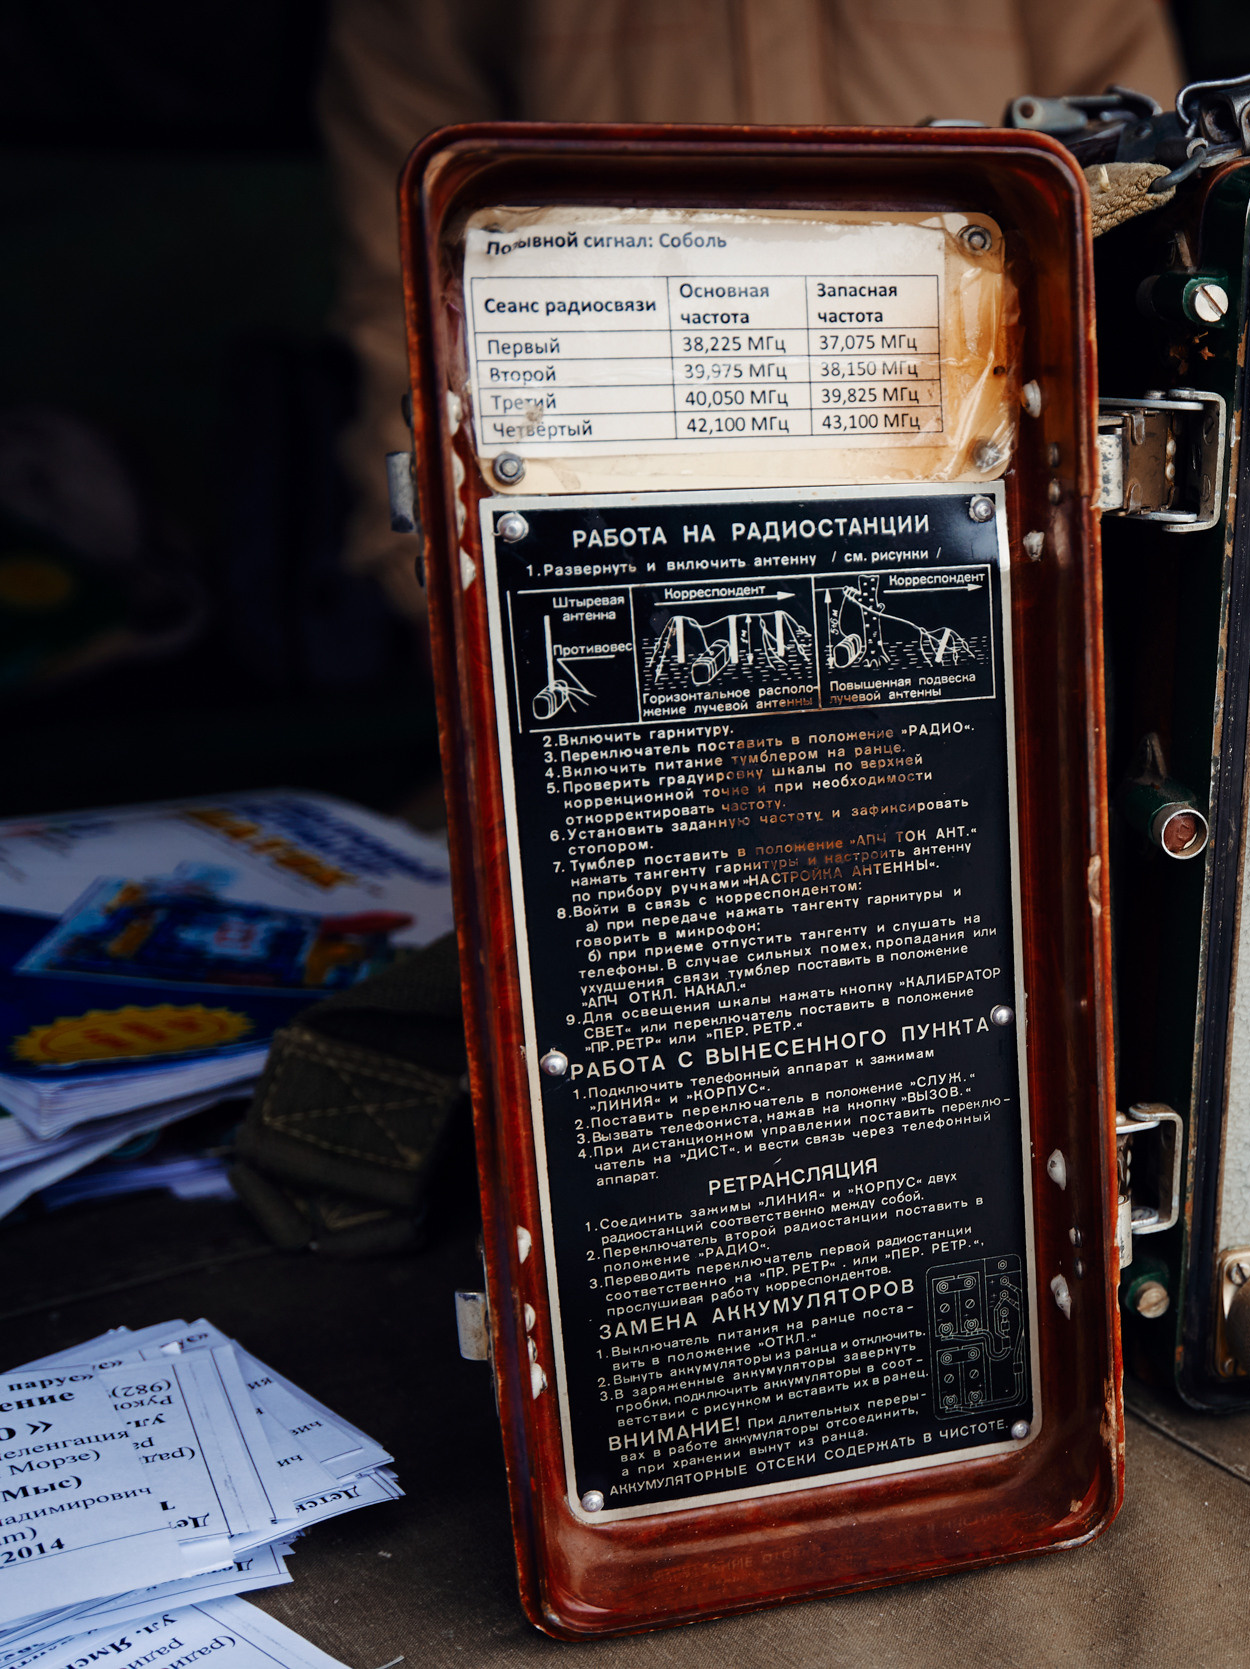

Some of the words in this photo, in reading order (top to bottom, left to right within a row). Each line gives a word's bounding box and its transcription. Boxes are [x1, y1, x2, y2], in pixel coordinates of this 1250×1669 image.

[583, 235, 653, 249] сигнал:
[658, 232, 728, 249] Соболь
[679, 282, 770, 299] Основная
[816, 282, 898, 298] Запасная
[484, 297, 540, 314] Сеанс
[545, 298, 657, 316] радиосвязи
[680, 311, 750, 325] частота
[817, 310, 884, 323] частота
[487, 337, 561, 358] Первый
[682, 335, 742, 354] 38,225
[748, 334, 787, 353] МГц
[819, 334, 875, 353] 37,075
[880, 333, 918, 351] МГц
[489, 365, 557, 386] Второй
[684, 362, 743, 382] 39,975
[749, 361, 788, 380] МГц
[820, 361, 877, 380] 38,150
[882, 360, 919, 378] МГц
[490, 392, 557, 413] Третий
[685, 389, 745, 409] 40,050
[750, 388, 789, 407] МГц
[821, 387, 878, 407] 39,825
[882, 386, 920, 404] МГц
[493, 419, 593, 440] Четвёртый
[686, 416, 746, 436] 42,100
[751, 416, 790, 435] МГц
[822, 414, 879, 433] 43,100
[883, 413, 921, 430] МГц
[570, 524, 668, 549] РАБОТА
[681, 522, 716, 544] НА
[729, 513, 930, 544] РАДИОСТАНЦИИ
[887, 572, 986, 588] Корреспондент
[550, 594, 626, 609] Штыревая
[664, 585, 767, 603] Корреспондент
[561, 609, 617, 623] антенна
[552, 641, 634, 658] Противовес
[829, 676, 912, 694] Повышенная
[917, 672, 977, 688] подвеска
[641, 687, 751, 706] Горизонтальное
[641, 704, 687, 718] жение
[692, 698, 749, 715] лучевой
[754, 696, 813, 710] антенны
[828, 689, 881, 706] лучевой
[887, 686, 942, 700] антенны
[562, 786, 695, 810] коррекционной
[701, 784, 749, 798] точке
[756, 783, 766, 793] и
[773, 780, 804, 794] при
[811, 770, 933, 790] необходимости
[564, 803, 715, 826] откорректировать
[566, 839, 654, 856] стопором.
[569, 872, 628, 888] нажать
[632, 865, 706, 881] тангенту
[714, 856, 799, 875] гарнитуры
[807, 855, 817, 866] и
[823, 847, 906, 864] настроить
[911, 841, 972, 856] антенну
[627, 986, 677, 1004] ОТКЛ.
[639, 1021, 667, 1034] или
[672, 1008, 793, 1030] переключатель
[798, 998, 875, 1016] поставить
[880, 996, 890, 1007] в
[895, 987, 974, 1005] положение
[571, 1053, 666, 1082] РАБОТА
[676, 1049, 694, 1069] С
[704, 1027, 887, 1066] ВЫНЕСЕННОГО
[900, 1015, 990, 1043] ПУНКТА
[668, 1094, 679, 1105] и
[593, 1157, 646, 1172] чатель
[652, 1152, 672, 1165] на
[743, 1143, 753, 1153] и
[757, 1137, 799, 1152] вести
[803, 1131, 846, 1146] связь
[851, 1124, 895, 1139] через
[900, 1109, 991, 1133] телефонный
[707, 1156, 878, 1196] РЕТРАНСЛЯЦИЯ
[600, 1218, 703, 1247] радиостанций
[709, 1204, 825, 1230] соответственно
[829, 1197, 876, 1213] между
[879, 1188, 924, 1206] собой.
[605, 1293, 704, 1317] прослушивая
[709, 1285, 760, 1304] работу
[764, 1264, 892, 1293] корреспондентов.
[598, 1310, 698, 1340] ЗАМЕНА
[710, 1277, 915, 1324] АККУМУЛЯТОРОВ
[607, 1414, 740, 1452] ВНИМАНИЕ!
[8, 1448, 101, 1476] Морзе)
[608, 1462, 748, 1496] АККУМУЛЯТОРНЫЕ
[754, 1451, 816, 1473] ОТСЕКИ
[823, 1435, 916, 1461] СОДЕРЖАТЬ
[921, 1431, 933, 1444] В
[938, 1417, 1009, 1440] ЧИСТОТЕ.
[620, 1467, 630, 1477] а
[636, 1461, 665, 1475] при
[671, 1449, 741, 1469] хранении
[748, 1440, 792, 1456] вынут
[797, 1436, 814, 1448] из
[820, 1427, 868, 1446] ранца.
